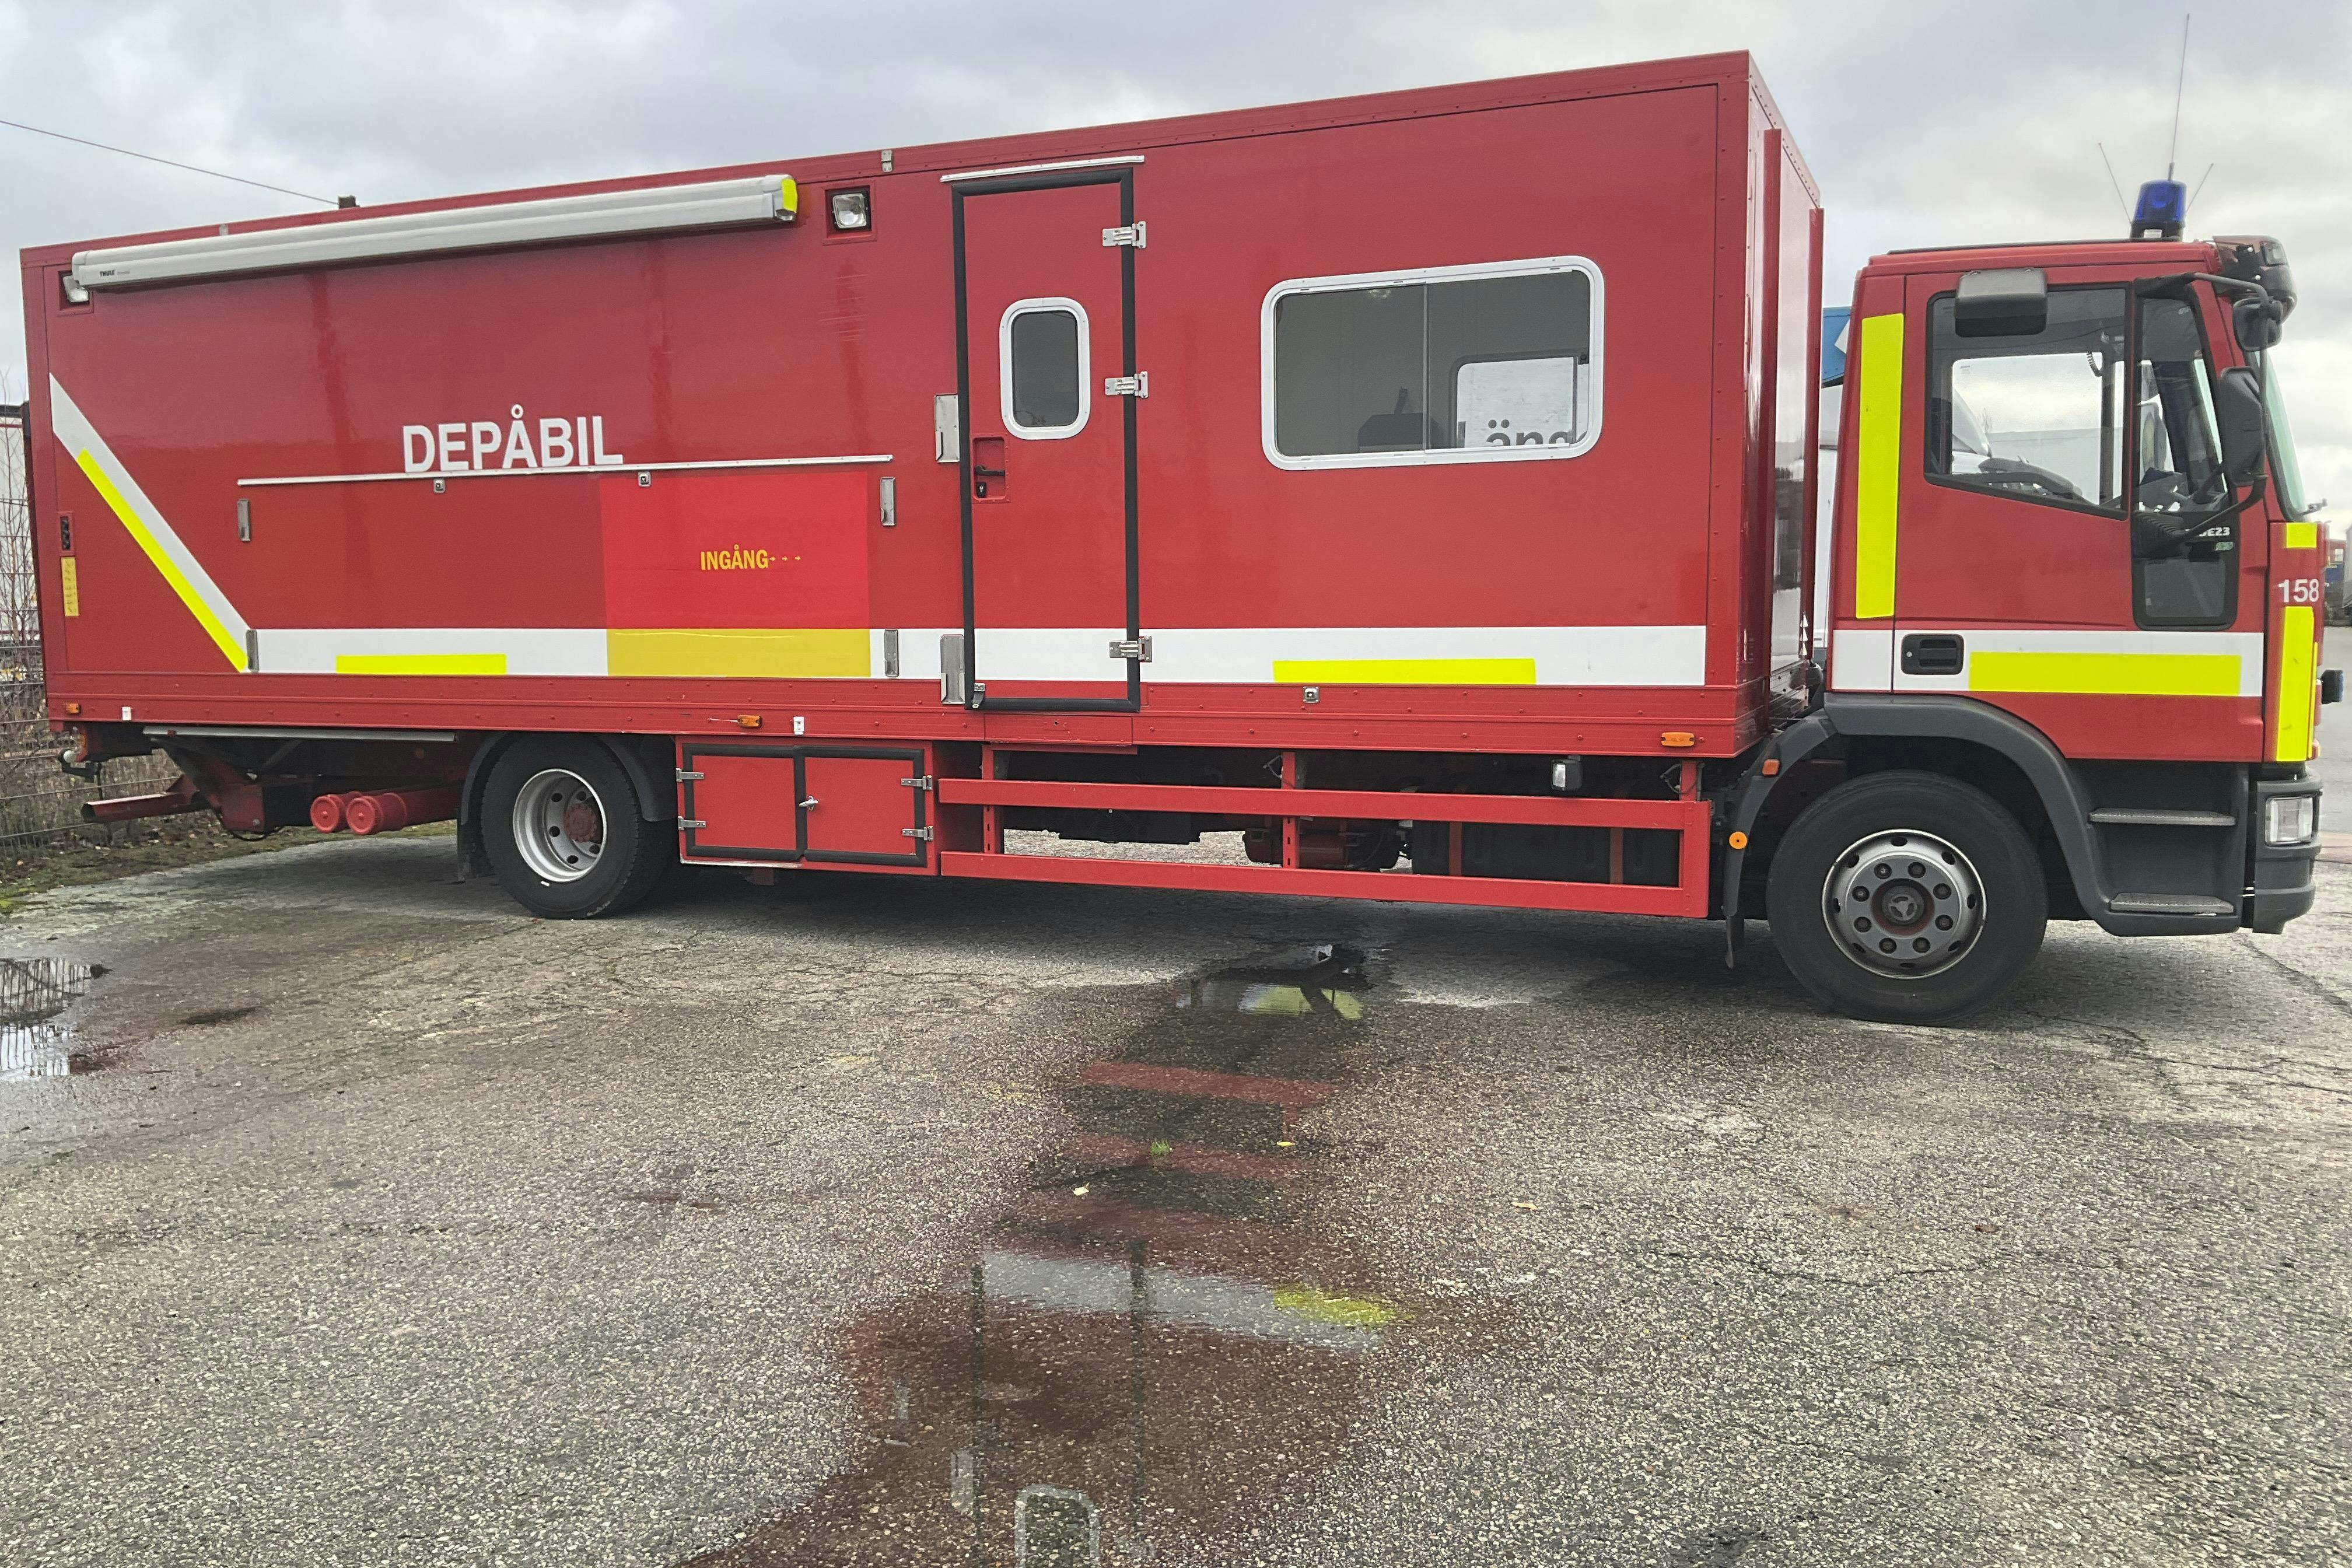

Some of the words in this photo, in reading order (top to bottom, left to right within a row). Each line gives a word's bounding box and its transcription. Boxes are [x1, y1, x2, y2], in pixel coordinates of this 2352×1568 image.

[402, 404, 624, 473] DEPÅBIL
[700, 544, 769, 570] INGÅNG
[2278, 579, 2319, 603] 158
